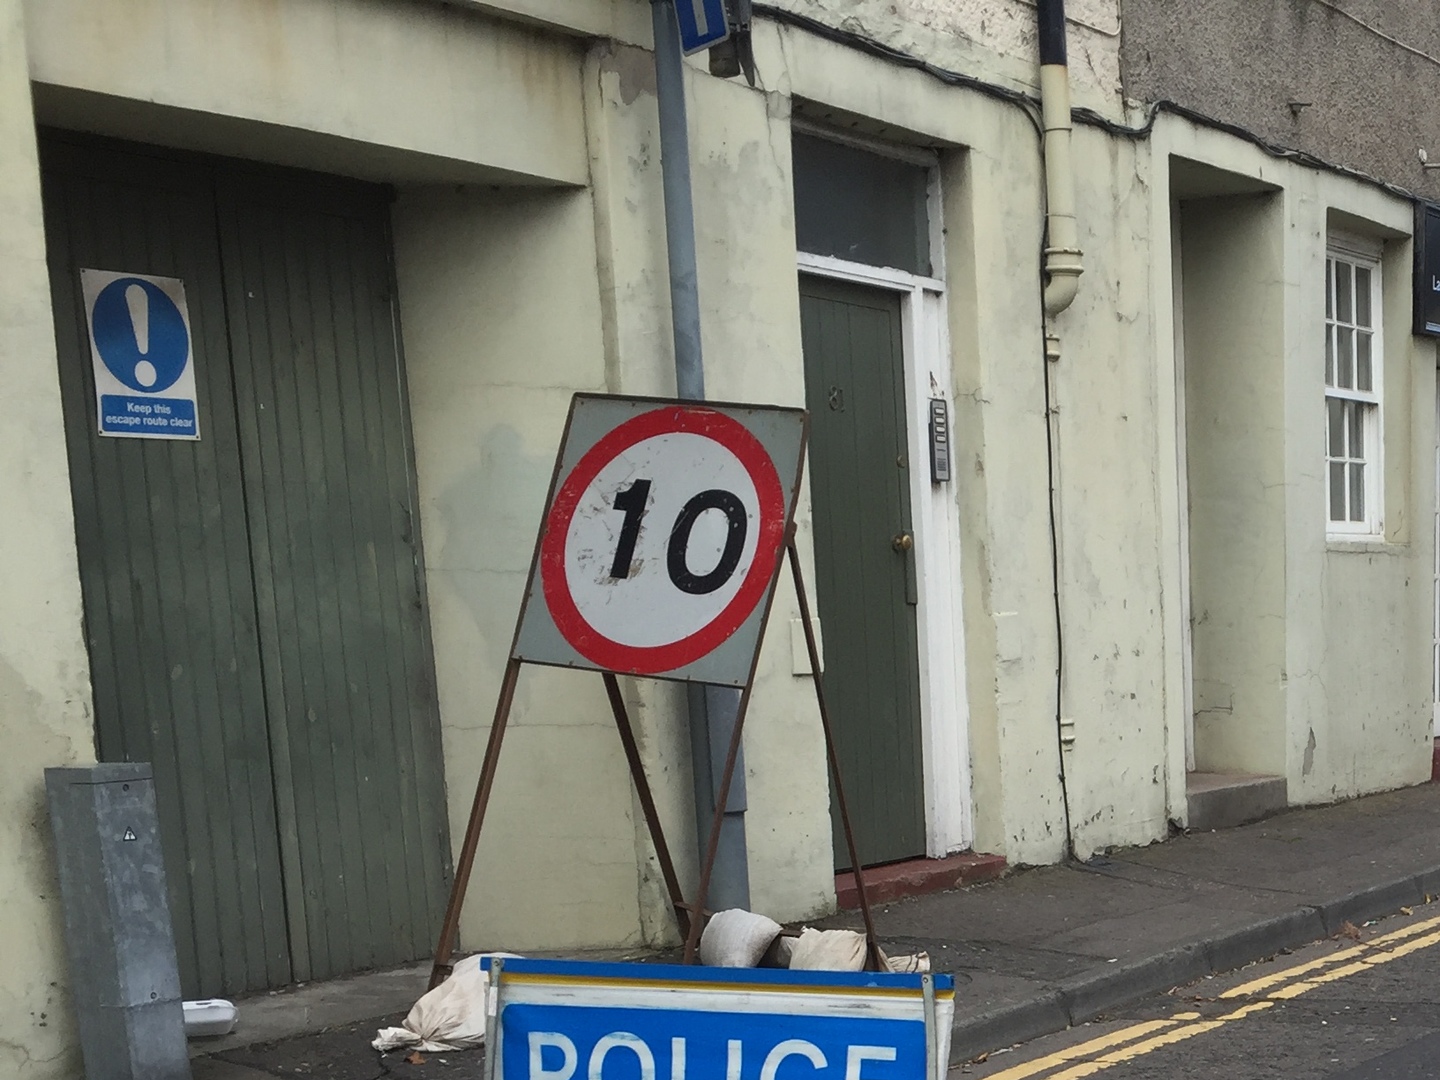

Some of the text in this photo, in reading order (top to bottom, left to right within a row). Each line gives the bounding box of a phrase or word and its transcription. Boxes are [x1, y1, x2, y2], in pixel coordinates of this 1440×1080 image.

[126, 401, 171, 415] Keep this
[105, 415, 193, 427] escape route clear
[610, 478, 748, 595] 10
